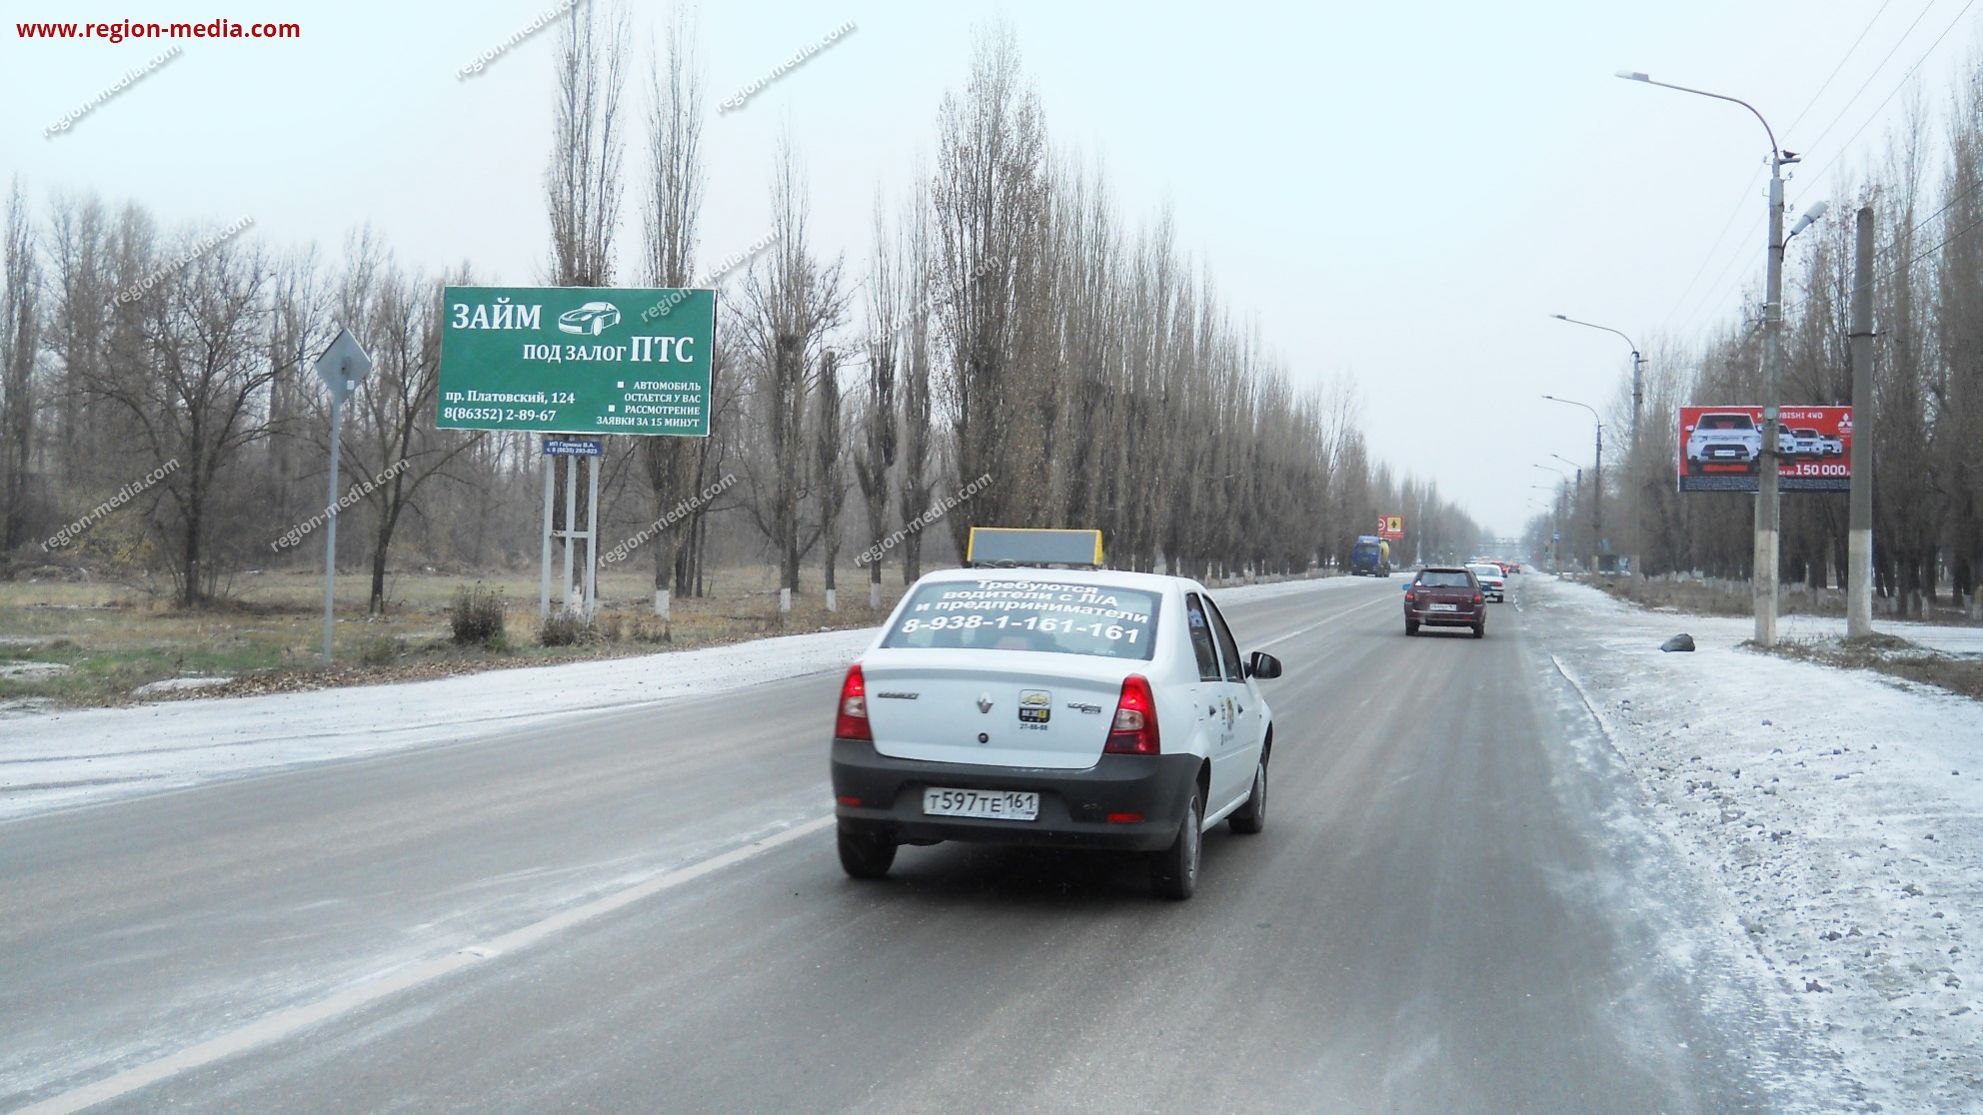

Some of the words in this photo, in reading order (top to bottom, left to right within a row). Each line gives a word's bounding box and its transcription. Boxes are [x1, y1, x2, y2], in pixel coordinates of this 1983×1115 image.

[452, 297, 542, 330] ЗАЙМ
[523, 344, 562, 363] ПОД
[565, 346, 627, 362] ЗАЛОГ
[630, 335, 695, 363] ПТС
[633, 381, 702, 391] АВТОМОБИЛЬ
[445, 391, 465, 403] пр.
[467, 390, 548, 405] Платовский,
[551, 392, 576, 404] 124
[624, 393, 672, 402] ОСТАЕТСЯ
[673, 394, 681, 403] У
[682, 394, 702, 403] ВАС
[444, 408, 503, 422] 8(86352)
[506, 409, 557, 422] 2-89-67
[624, 405, 701, 415] РАССМОТРЕНИЕ
[596, 416, 635, 426] ЗАЯВКИ
[636, 418, 649, 426] ЗА
[651, 418, 663, 426] 15
[664, 418, 700, 427] МИНУТ
[1795, 464, 1819, 475] 150
[1821, 464, 1846, 475] 000
[976, 580, 1099, 595] Требуются
[942, 590, 1053, 601] водители
[915, 602, 930, 612] и
[935, 600, 1149, 624] предприниматели
[901, 614, 1140, 644] 8-938-1-161-161
[1006, 793, 1034, 810] 161
